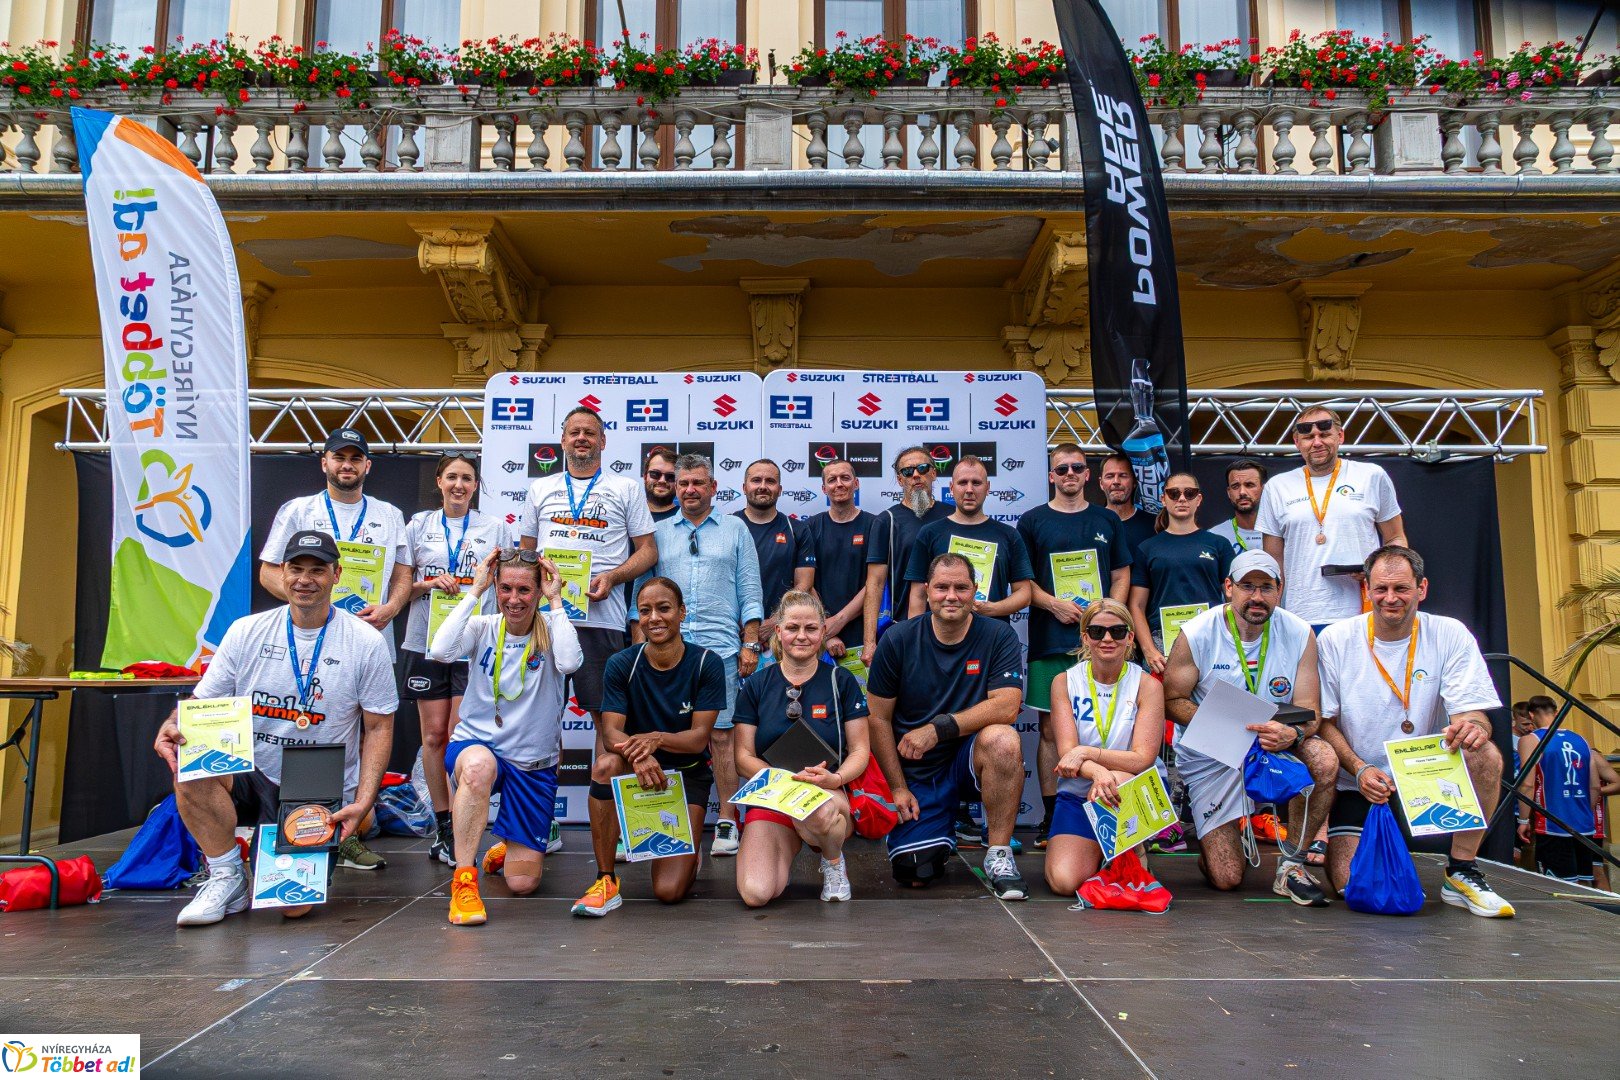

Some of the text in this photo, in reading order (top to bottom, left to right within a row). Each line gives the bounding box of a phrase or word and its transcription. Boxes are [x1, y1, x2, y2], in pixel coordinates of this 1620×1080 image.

[583, 375, 658, 384] STREETBALL
[696, 375, 740, 383] SUZUKI
[863, 374, 938, 383] STREETBALL
[978, 373, 1021, 381] SUZUKI
[697, 421, 753, 430] SUZUKI
[841, 420, 897, 429] SUZUKI
[978, 420, 1035, 430] SUZUKI
[986, 514, 1022, 522] UZUK
[549, 529, 606, 544] STRETBALL
[186, 703, 230, 711] EMLÉKLAP
[1073, 695, 1095, 723] 52
[562, 723, 596, 732] UZU
[253, 732, 316, 746] TREETBALL
[1394, 743, 1436, 755] EMLÉKLAP
